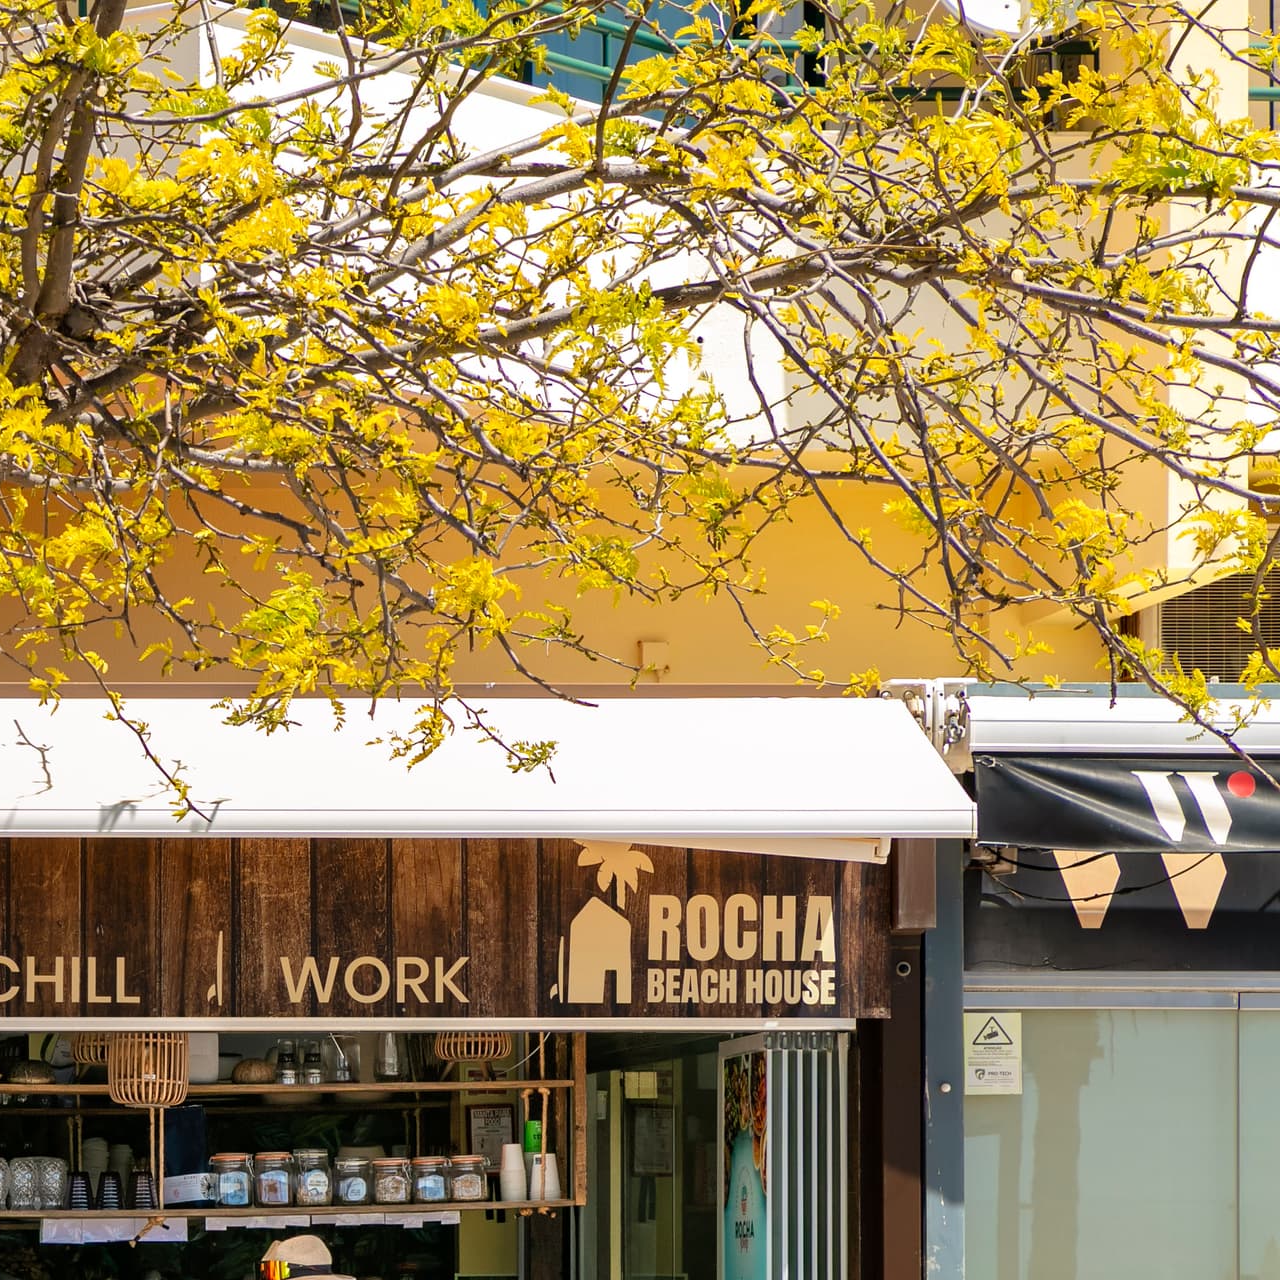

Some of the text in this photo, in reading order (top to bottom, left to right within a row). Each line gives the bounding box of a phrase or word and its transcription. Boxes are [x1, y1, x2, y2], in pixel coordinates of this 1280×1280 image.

[647, 894, 836, 962] ROCHA
[280, 955, 470, 1005] WORK
[647, 969, 836, 1006] BEACH HOUSE
[734, 1220, 755, 1239] ROCHA
